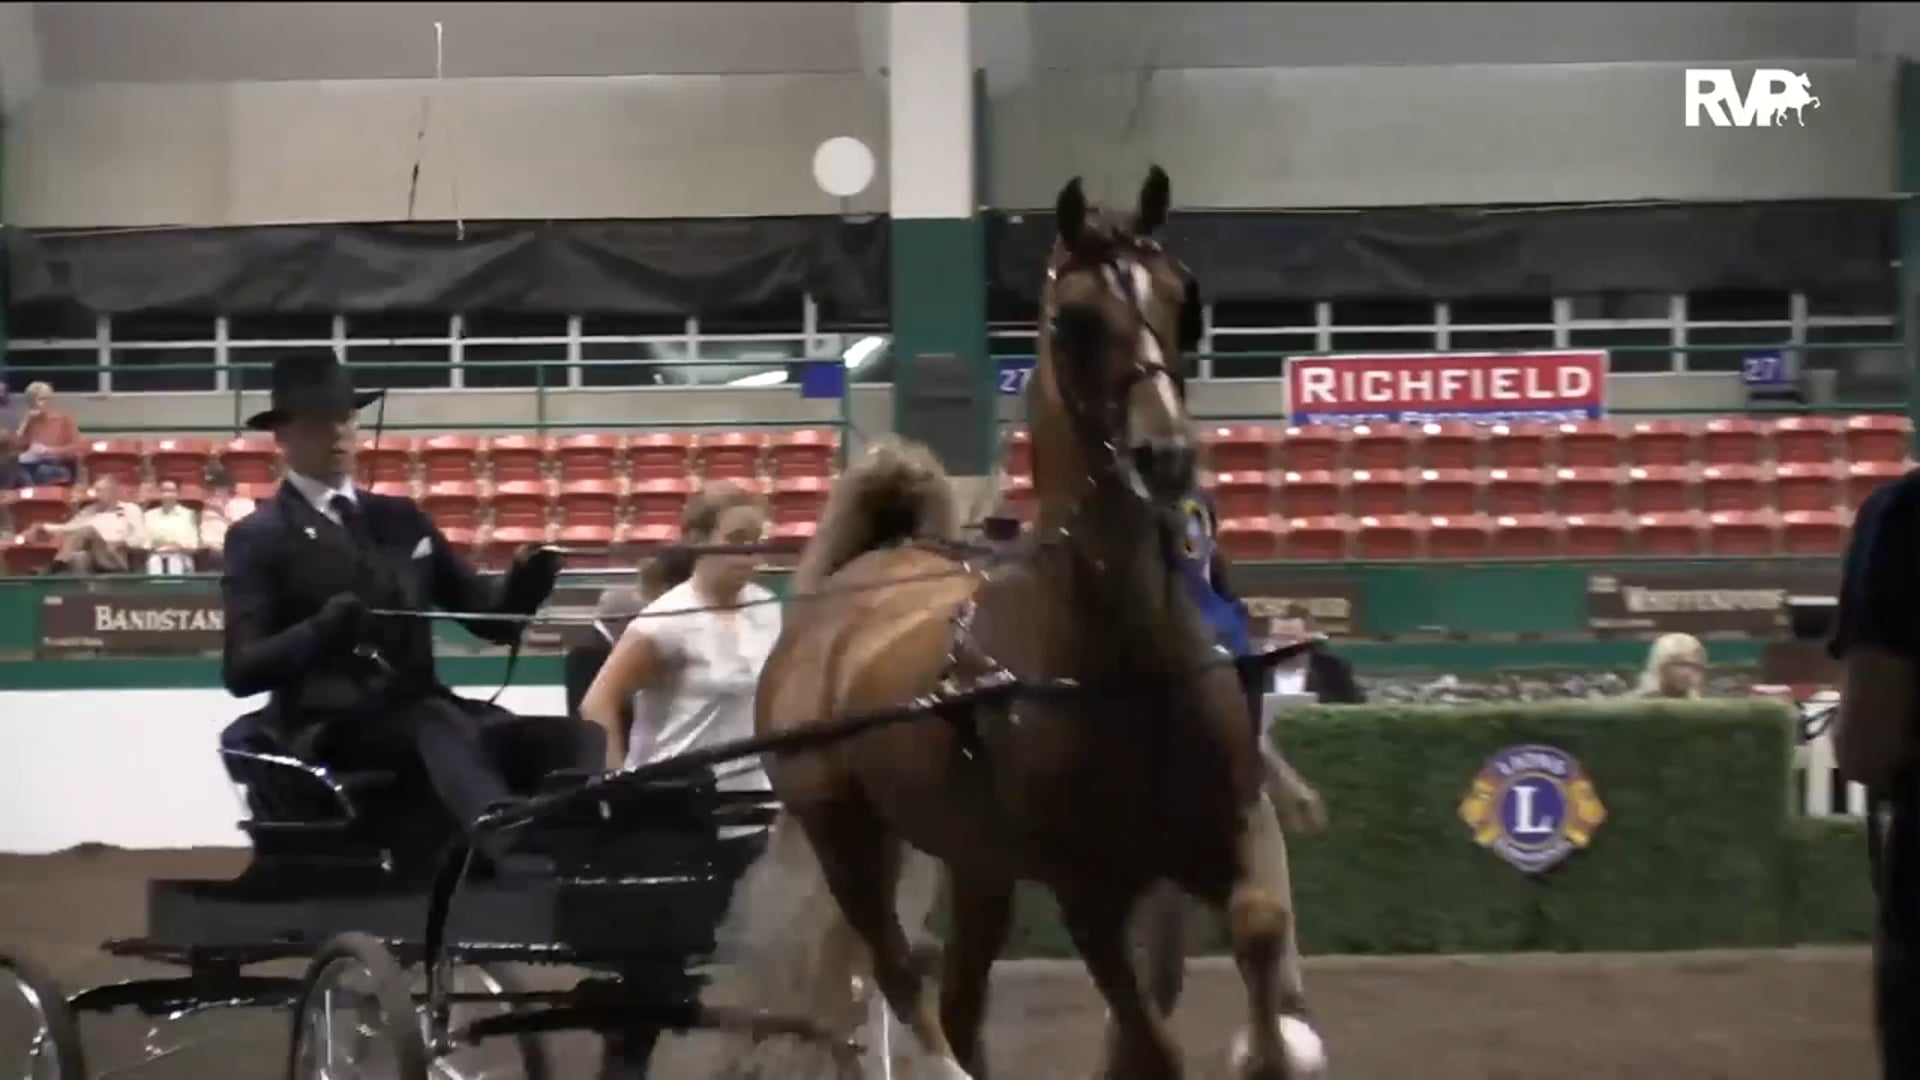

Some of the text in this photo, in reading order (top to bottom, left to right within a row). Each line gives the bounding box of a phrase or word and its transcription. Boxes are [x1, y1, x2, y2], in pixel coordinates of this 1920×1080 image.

[1000, 368, 1032, 393] 27
[1299, 365, 1593, 404] RICHFIELD
[1744, 357, 1777, 381] 27
[1513, 785, 1553, 833] L
